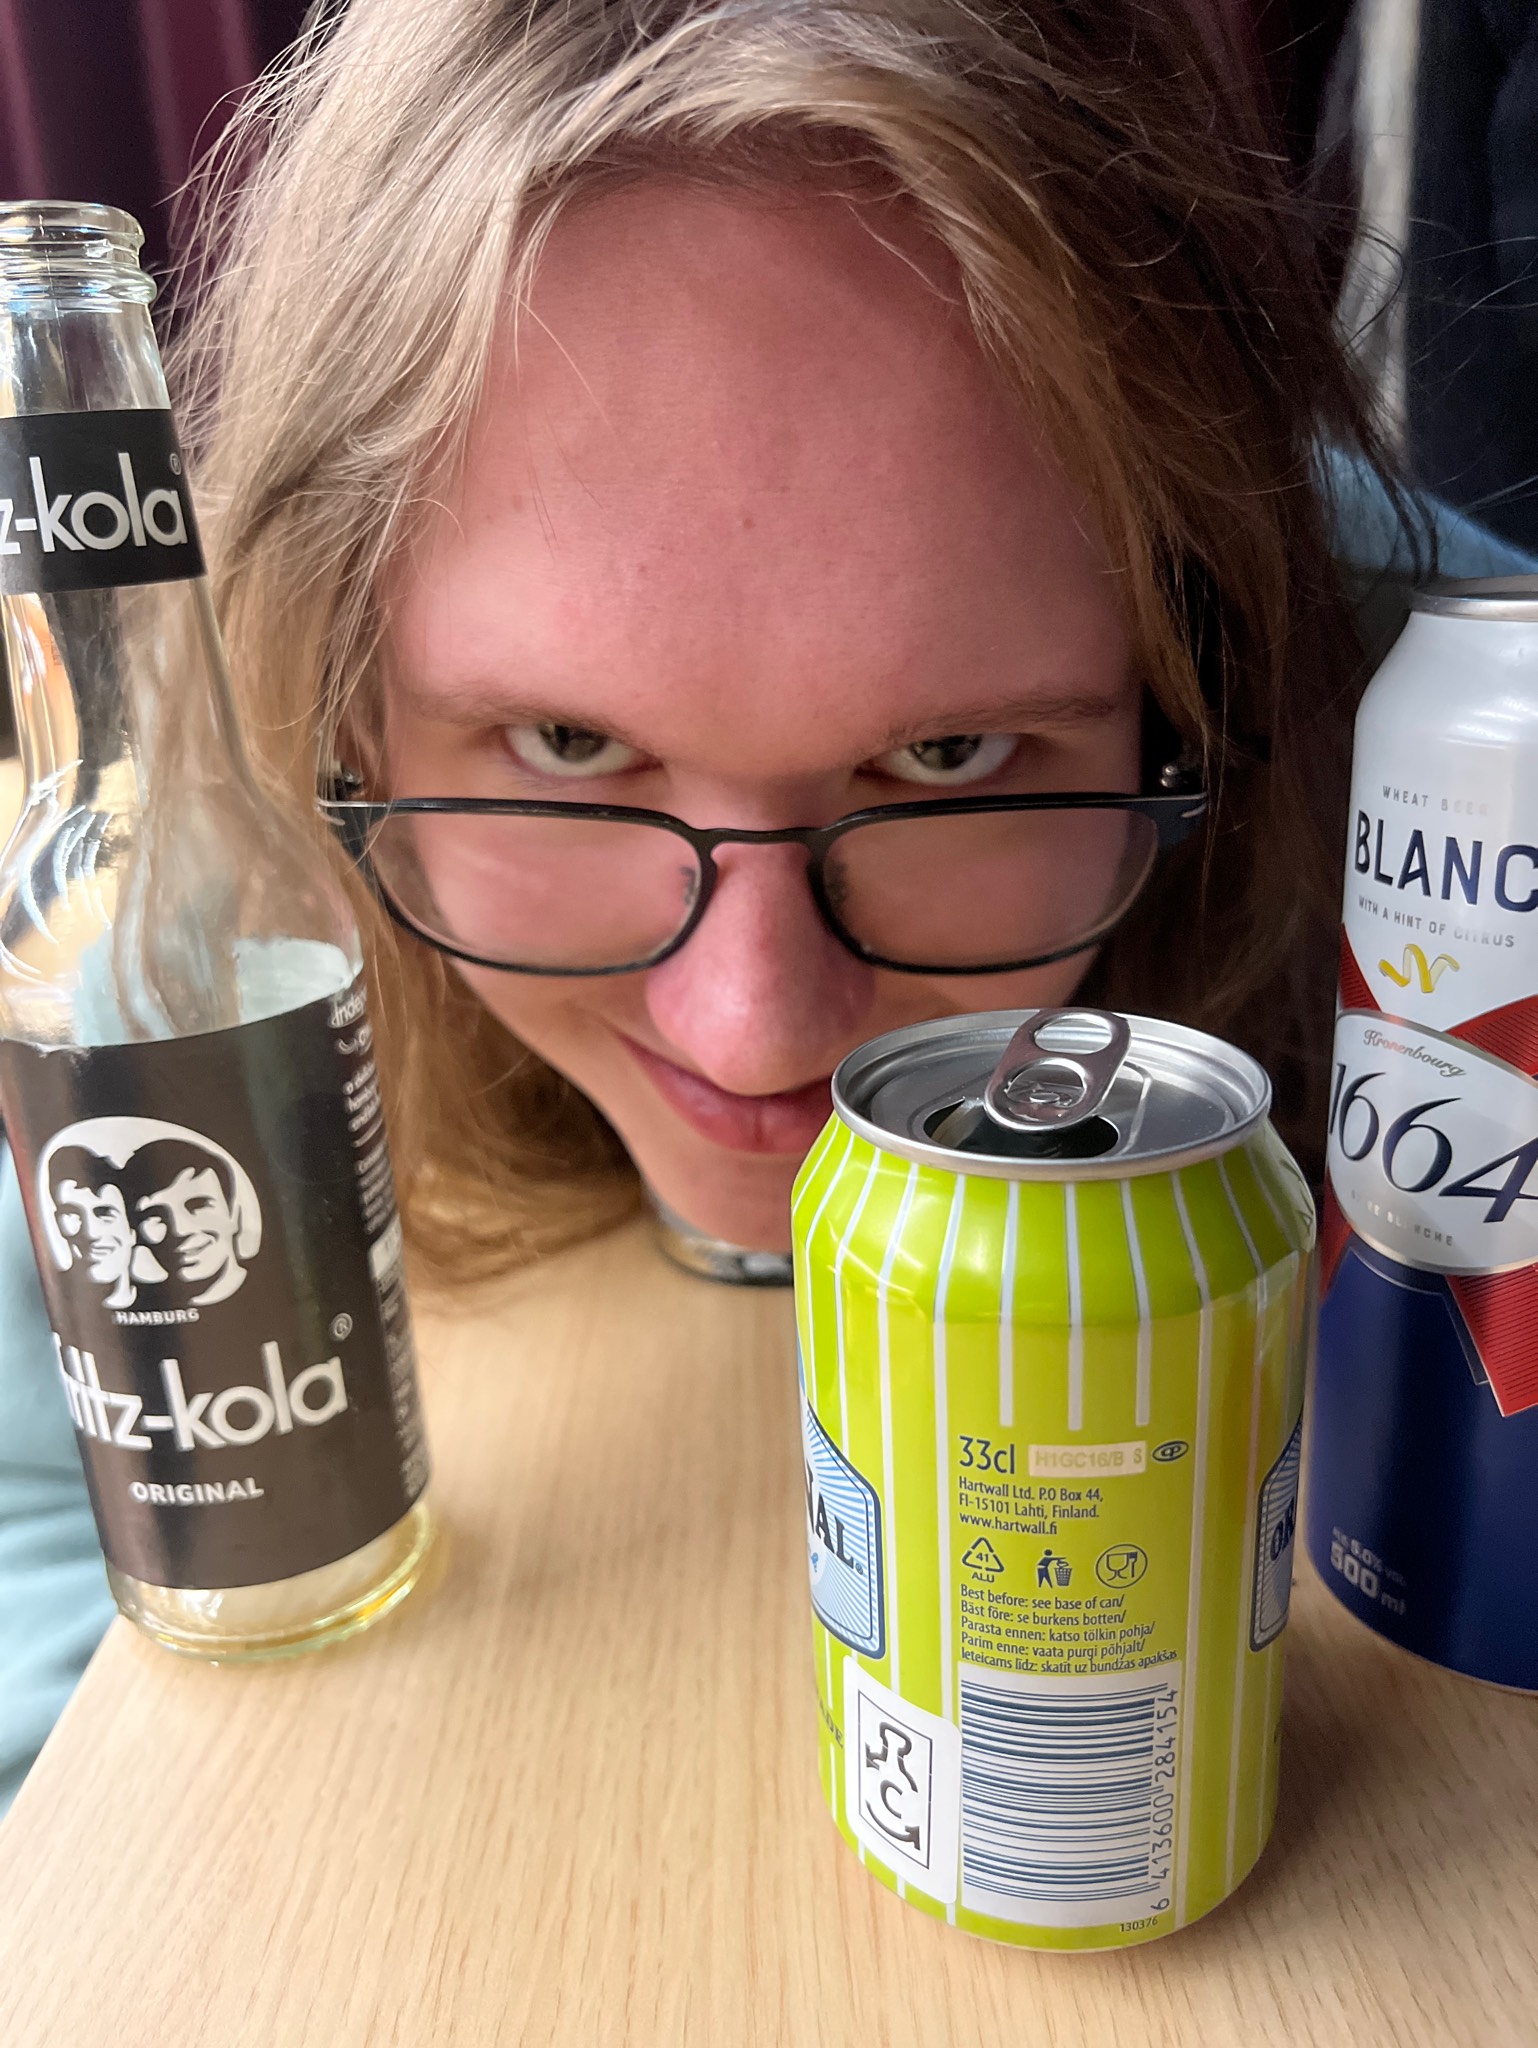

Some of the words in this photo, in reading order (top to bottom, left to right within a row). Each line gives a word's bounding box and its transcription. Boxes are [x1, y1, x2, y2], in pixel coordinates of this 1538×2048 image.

[1382, 784, 1429, 808] WHEAT
[1354, 808, 1538, 913] BLANC
[1357, 895, 1378, 915] WITH
[1382, 907, 1389, 921] A
[1393, 911, 1422, 930] HINT
[1429, 920, 1446, 937] OF
[1453, 926, 1515, 948] CITRUS
[1362, 1029, 1467, 1078] Kronenbourg
[1328, 1062, 1538, 1224] 1664
[113, 1307, 201, 1326] HAMBURG
[959, 1435, 1015, 1475] 33cl
[129, 1477, 264, 1504] ORIGINAL
[959, 1476, 1009, 1497] Hartwall
[1013, 1485, 1035, 1500] Ltd.
[1039, 1487, 1056, 1500] P.O
[1060, 1488, 1082, 1501] Box
[1085, 1488, 1103, 1503] 44,
[959, 1492, 1010, 1514] FI-15101
[1014, 1502, 1048, 1520] Lahti,
[1052, 1505, 1100, 1519] Finland.
[959, 1512, 1057, 1535] www.hartwall.fi
[975, 1552, 989, 1563] 41
[972, 1571, 995, 1584] ALU
[961, 1584, 984, 1601] Best
[987, 1589, 1028, 1608] before:
[1032, 1598, 1051, 1609] see
[1055, 1596, 1082, 1610] base
[1085, 1595, 1098, 1609] of
[1100, 1593, 1125, 1609] can/
[961, 1600, 984, 1617] Bäst
[987, 1606, 1013, 1622] före:
[1017, 1613, 1030, 1624] se
[1033, 1612, 1079, 1626] burkens
[1083, 1609, 1127, 1625] botten/
[961, 1615, 1002, 1636] Parasta
[1005, 1628, 1046, 1641] ennen:
[1049, 1628, 1080, 1642] katso
[1083, 1628, 1116, 1641] tölkin
[1119, 1620, 1156, 1642] pohja/
[961, 1631, 993, 1650] Parim
[996, 1642, 1029, 1655] enne:
[1032, 1646, 1064, 1658] vaata
[1067, 1645, 1098, 1661] purgi
[1074, 1664, 1088, 1673] uz
[1154, 1689, 1178, 1783] 284154
[1151, 1793, 1174, 1883] 413600
[1150, 1897, 1170, 1910] 6
[1119, 1916, 1158, 1932] 130376
